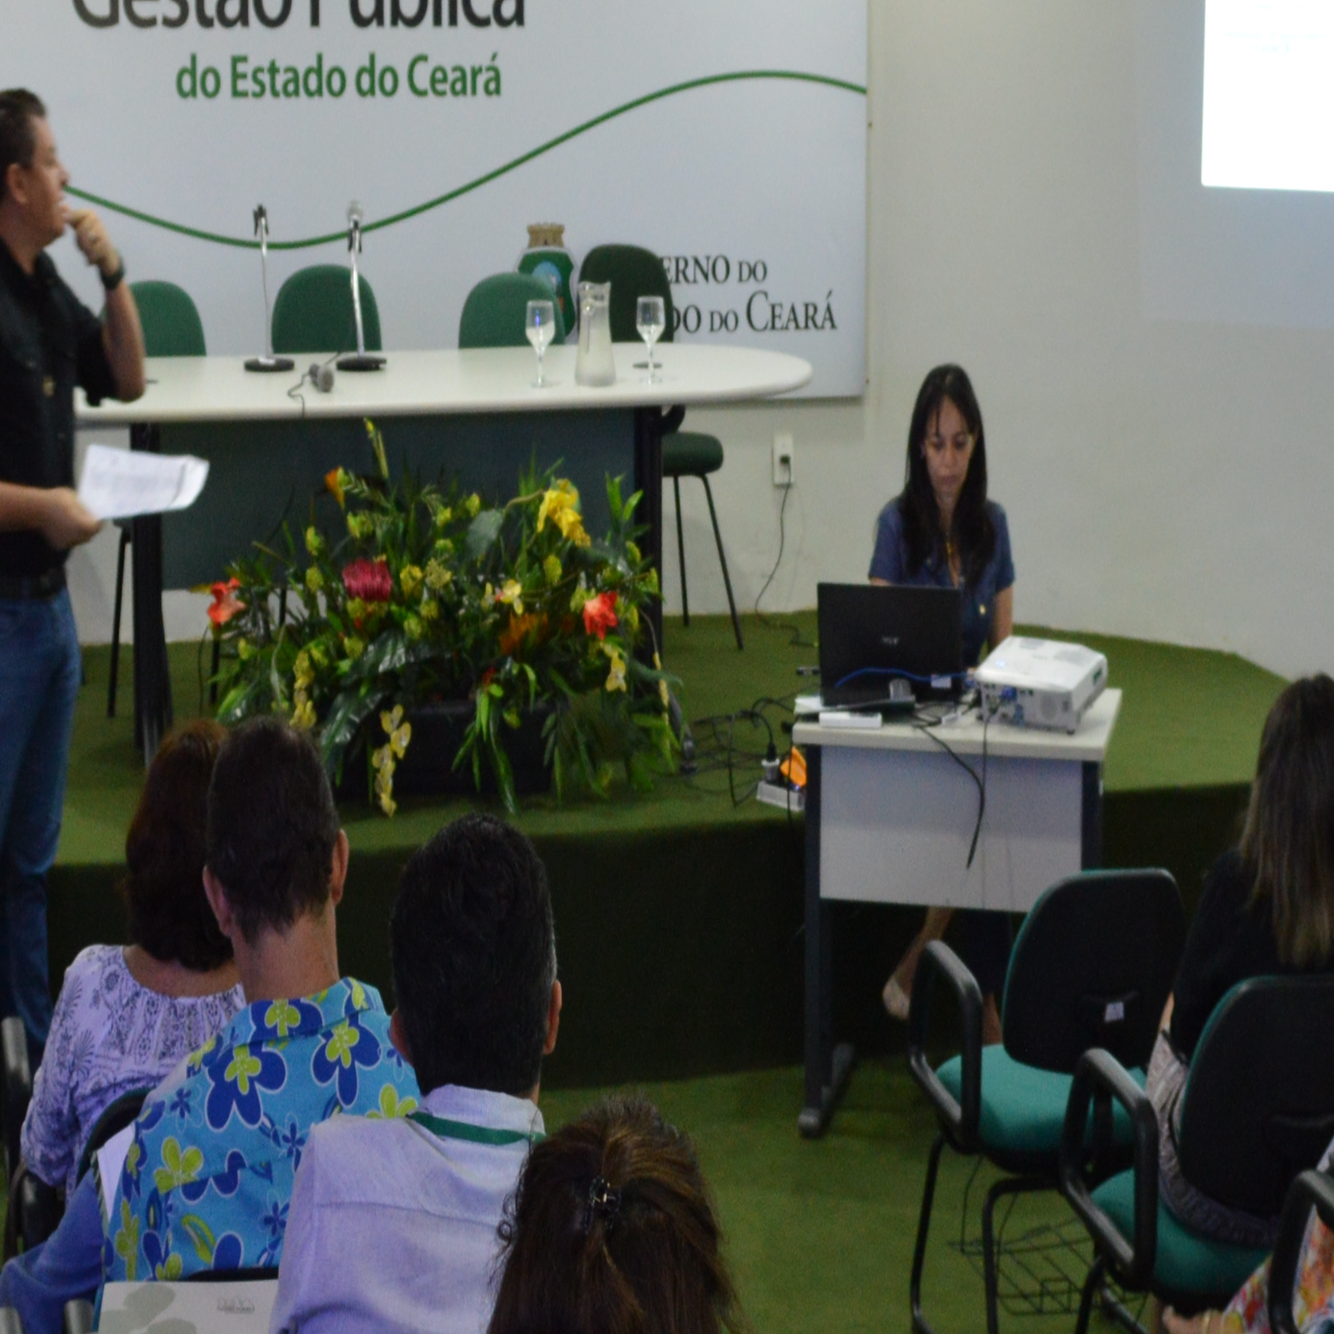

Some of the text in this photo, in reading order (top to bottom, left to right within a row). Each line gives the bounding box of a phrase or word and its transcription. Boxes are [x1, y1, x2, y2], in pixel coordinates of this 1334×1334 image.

[175, 52, 502, 100] do Estado do Ceará
[661, 254, 768, 284] ERNO DO
[709, 310, 740, 333] DO
[745, 290, 838, 333] CEARÁ
